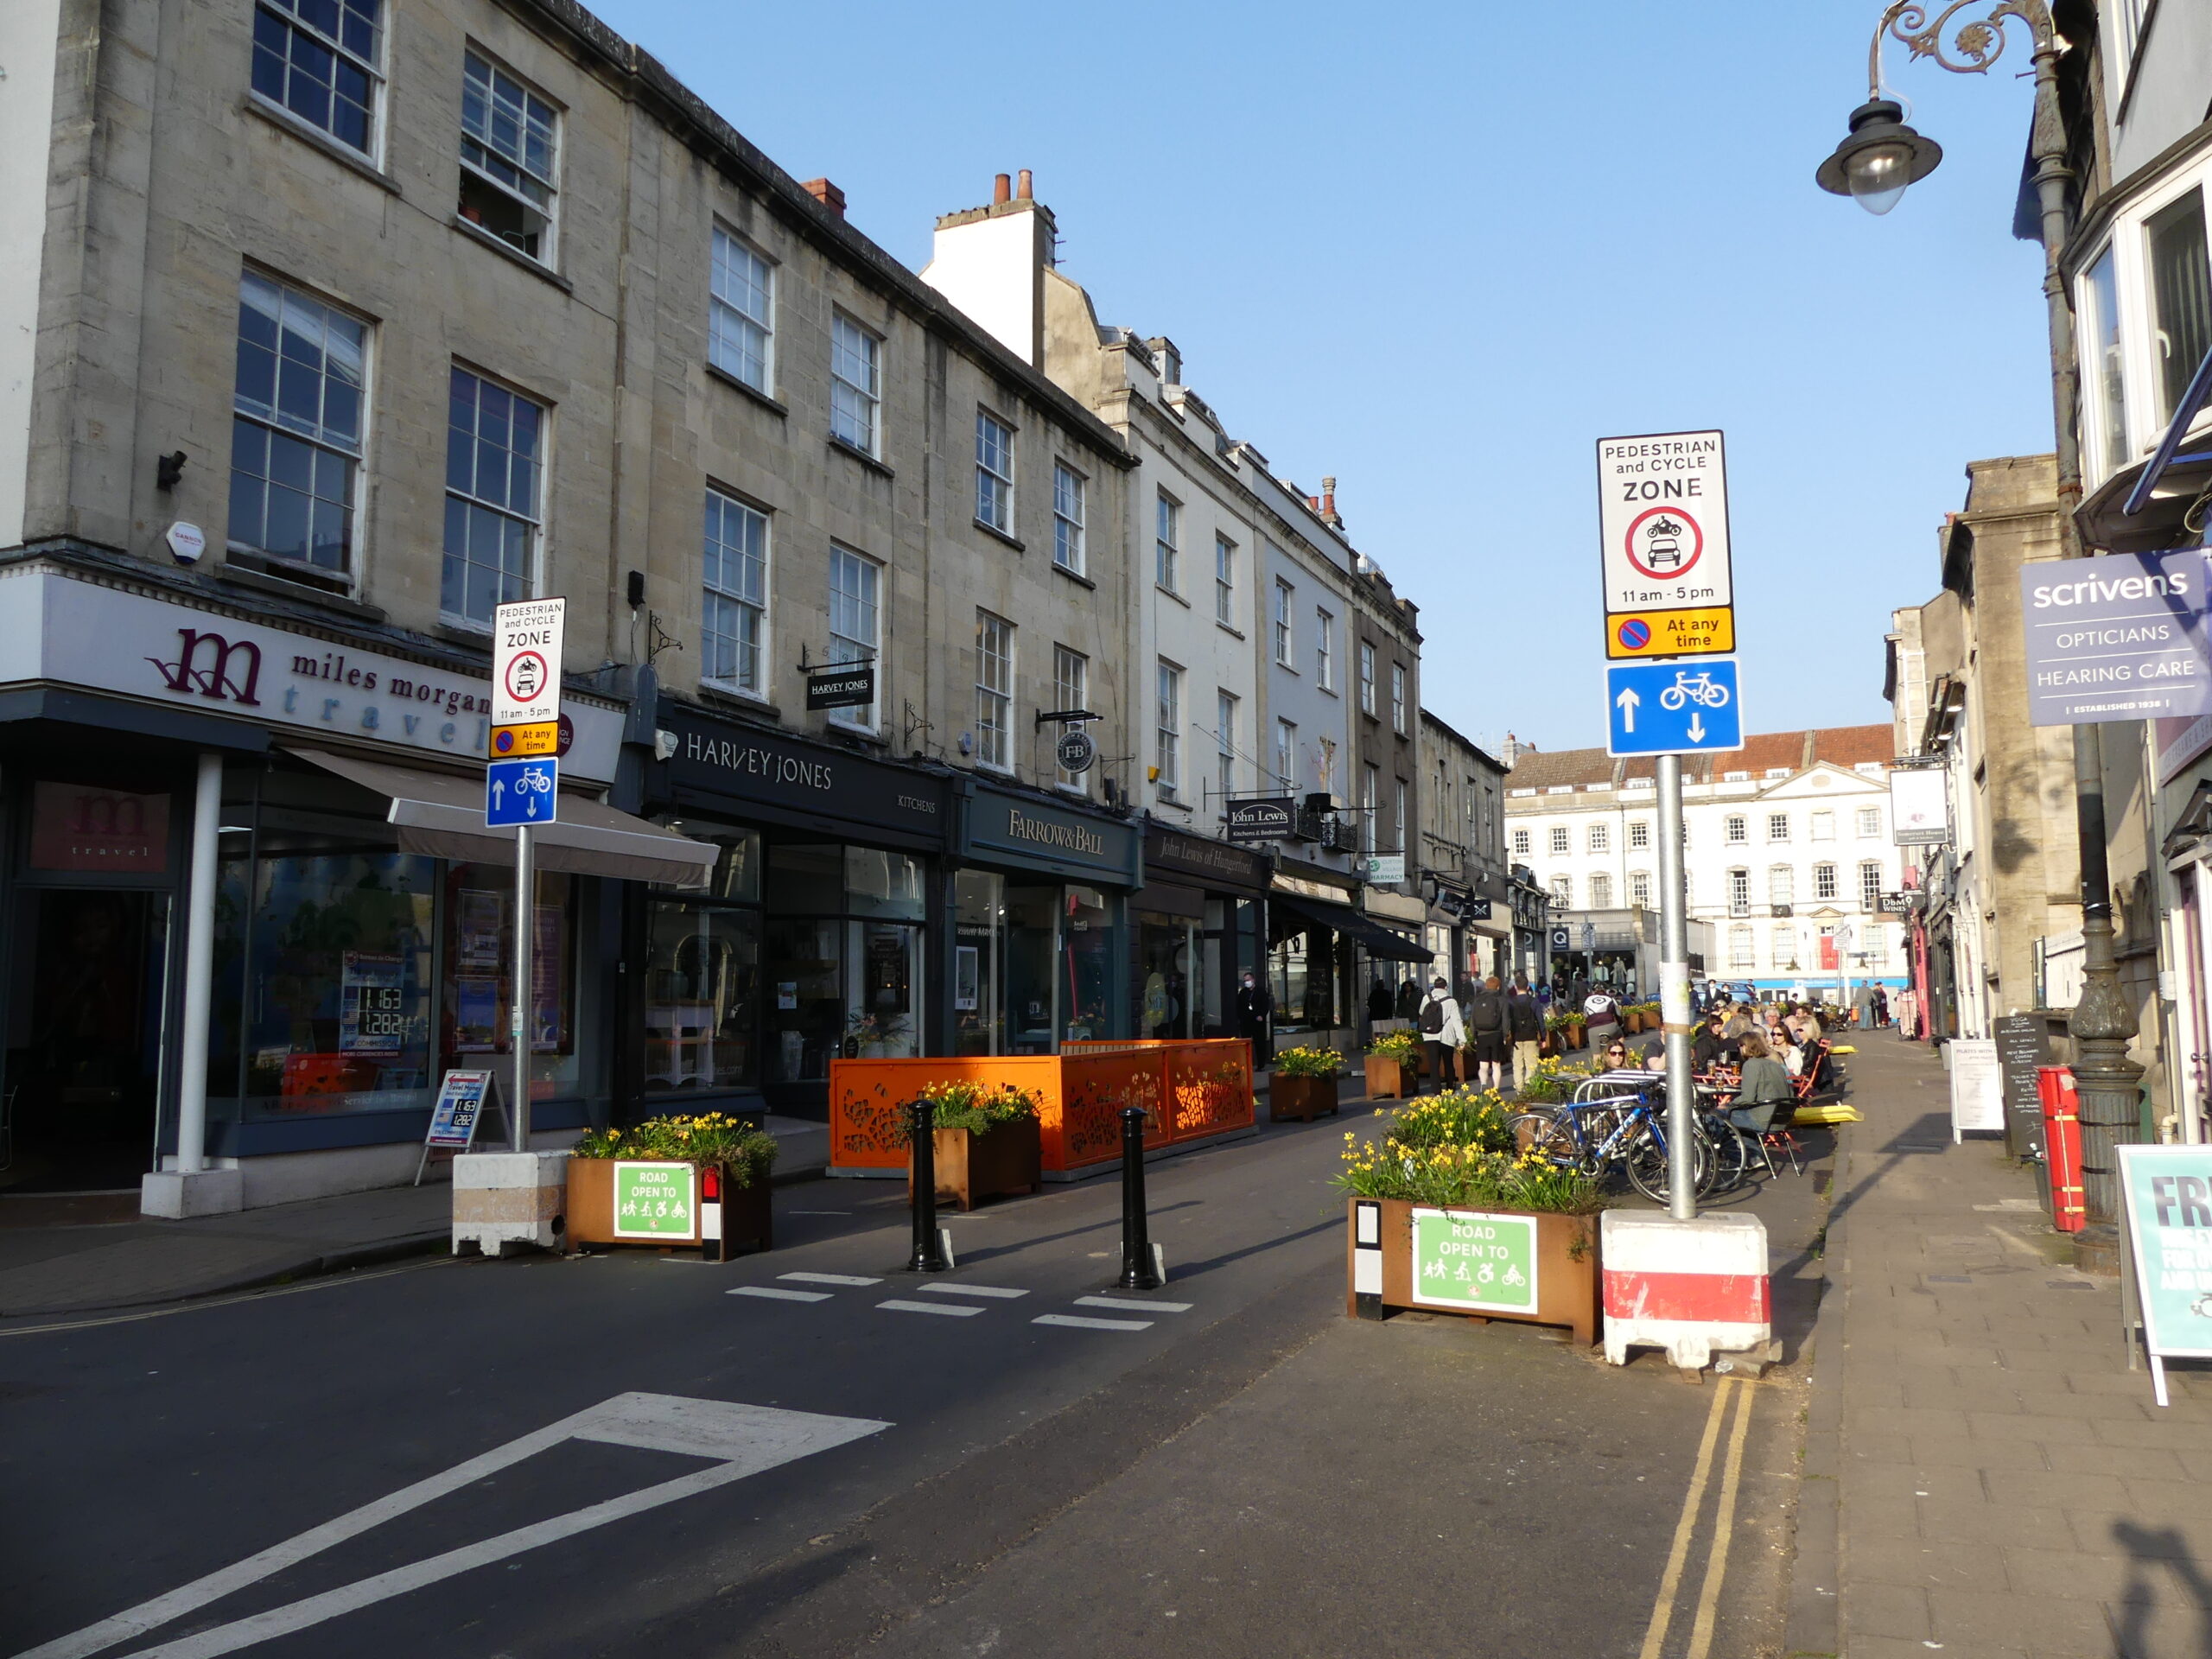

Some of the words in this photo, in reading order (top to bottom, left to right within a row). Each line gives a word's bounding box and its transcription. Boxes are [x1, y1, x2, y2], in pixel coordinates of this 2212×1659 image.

[1605, 440, 1716, 459] PEDESTRIAN
[1616, 461, 1643, 474] and
[1651, 456, 1707, 471] CYCLE
[1623, 478, 1702, 501] ZONE
[2033, 572, 2189, 608] scrivens
[499, 603, 562, 618] PEDESTRIAN
[505, 619, 521, 628] and
[524, 614, 556, 626] CYCLE
[1667, 619, 1686, 632] At
[1690, 620, 1719, 632] any
[507, 631, 550, 648] ZONE
[1675, 634, 1712, 647] time
[2056, 625, 2170, 649] OPTICIANS
[2037, 665, 2132, 687] HEARING
[2138, 660, 2195, 679] CARE
[291, 652, 377, 690] miles
[390, 675, 490, 715] morgan
[811, 683, 844, 695] HARVEY
[844, 679, 868, 691] JONES
[2074, 701, 2136, 714] ESTABLISHED
[2138, 700, 2161, 709] 1938
[522, 729, 534, 739] At
[536, 729, 551, 741] any
[526, 741, 546, 750] time
[687, 733, 773, 778] HARVEY
[776, 754, 831, 791] JONES
[897, 793, 936, 815] KITCHENS
[1231, 810, 1255, 824] John
[1257, 810, 1287, 822] Lewis
[1160, 836, 1180, 858] John
[1181, 842, 1203, 863] Lewis
[1205, 848, 1214, 865] of
[1213, 850, 1253, 874] Hungerford
[1882, 898, 1905, 906] DbM
[639, 1172, 668, 1183] ROAD
[632, 1186, 660, 1198] OPEN
[663, 1186, 677, 1198] TO
[2151, 1176, 2212, 1227] FR
[1452, 1224, 1496, 1241] ROAD
[1439, 1242, 1483, 1257] OPEN
[1488, 1244, 1509, 1260] TO
